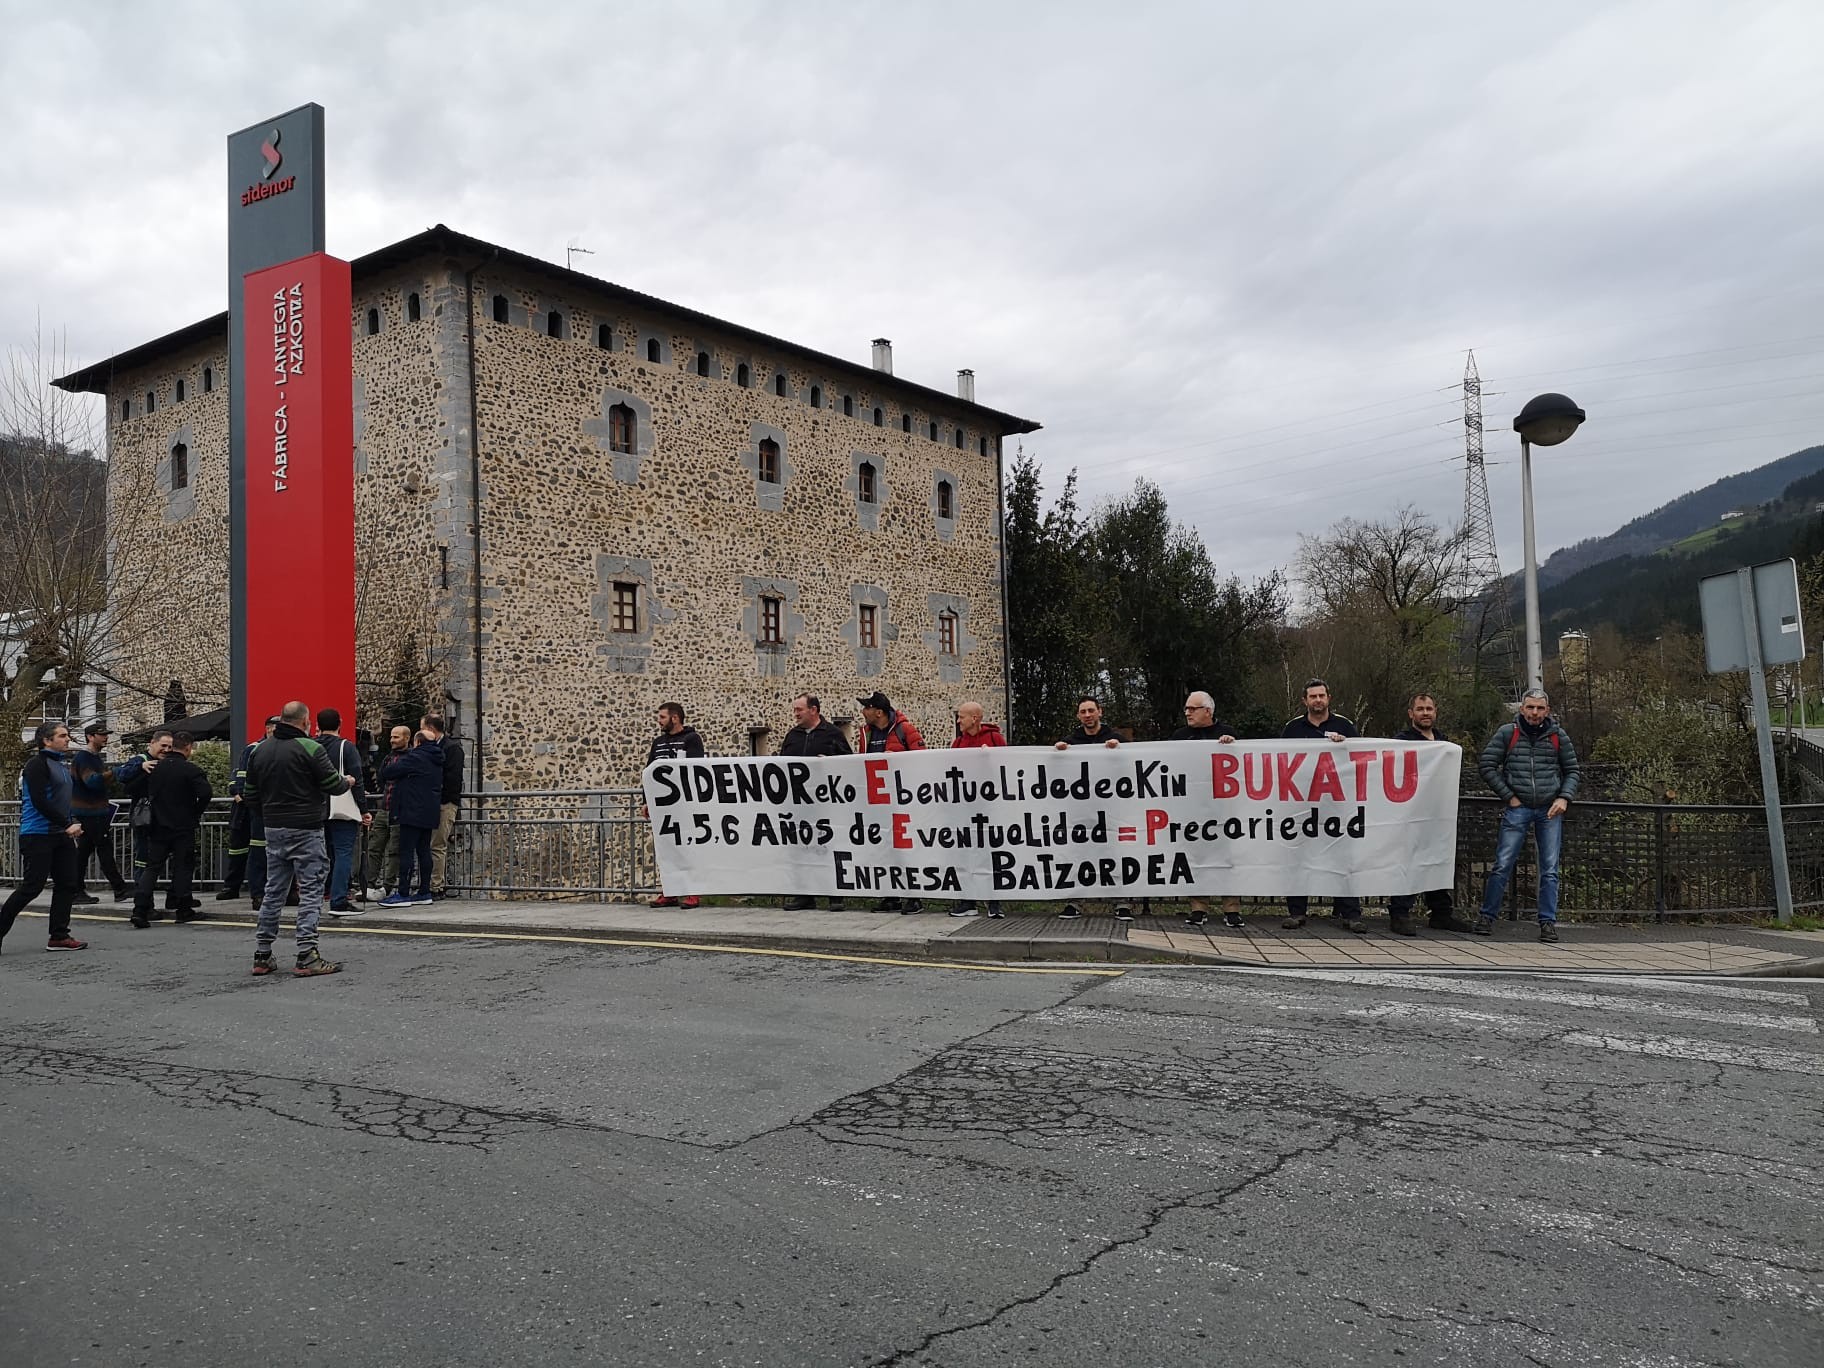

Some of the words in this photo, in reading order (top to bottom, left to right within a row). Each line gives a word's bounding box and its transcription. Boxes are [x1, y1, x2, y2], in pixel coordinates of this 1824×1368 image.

[240, 175, 296, 207] sidenor
[274, 287, 288, 385] LANTEGIA
[271, 404, 288, 493] FÁBRICA
[1212, 751, 1419, 803] BUKATU
[752, 811, 834, 846] Años
[848, 811, 882, 846] de
[1118, 826, 1137, 842] =
[1146, 806, 1366, 846] Precariedad
[834, 850, 962, 892] ENPRESA
[991, 850, 1195, 891] BATZORDEA
